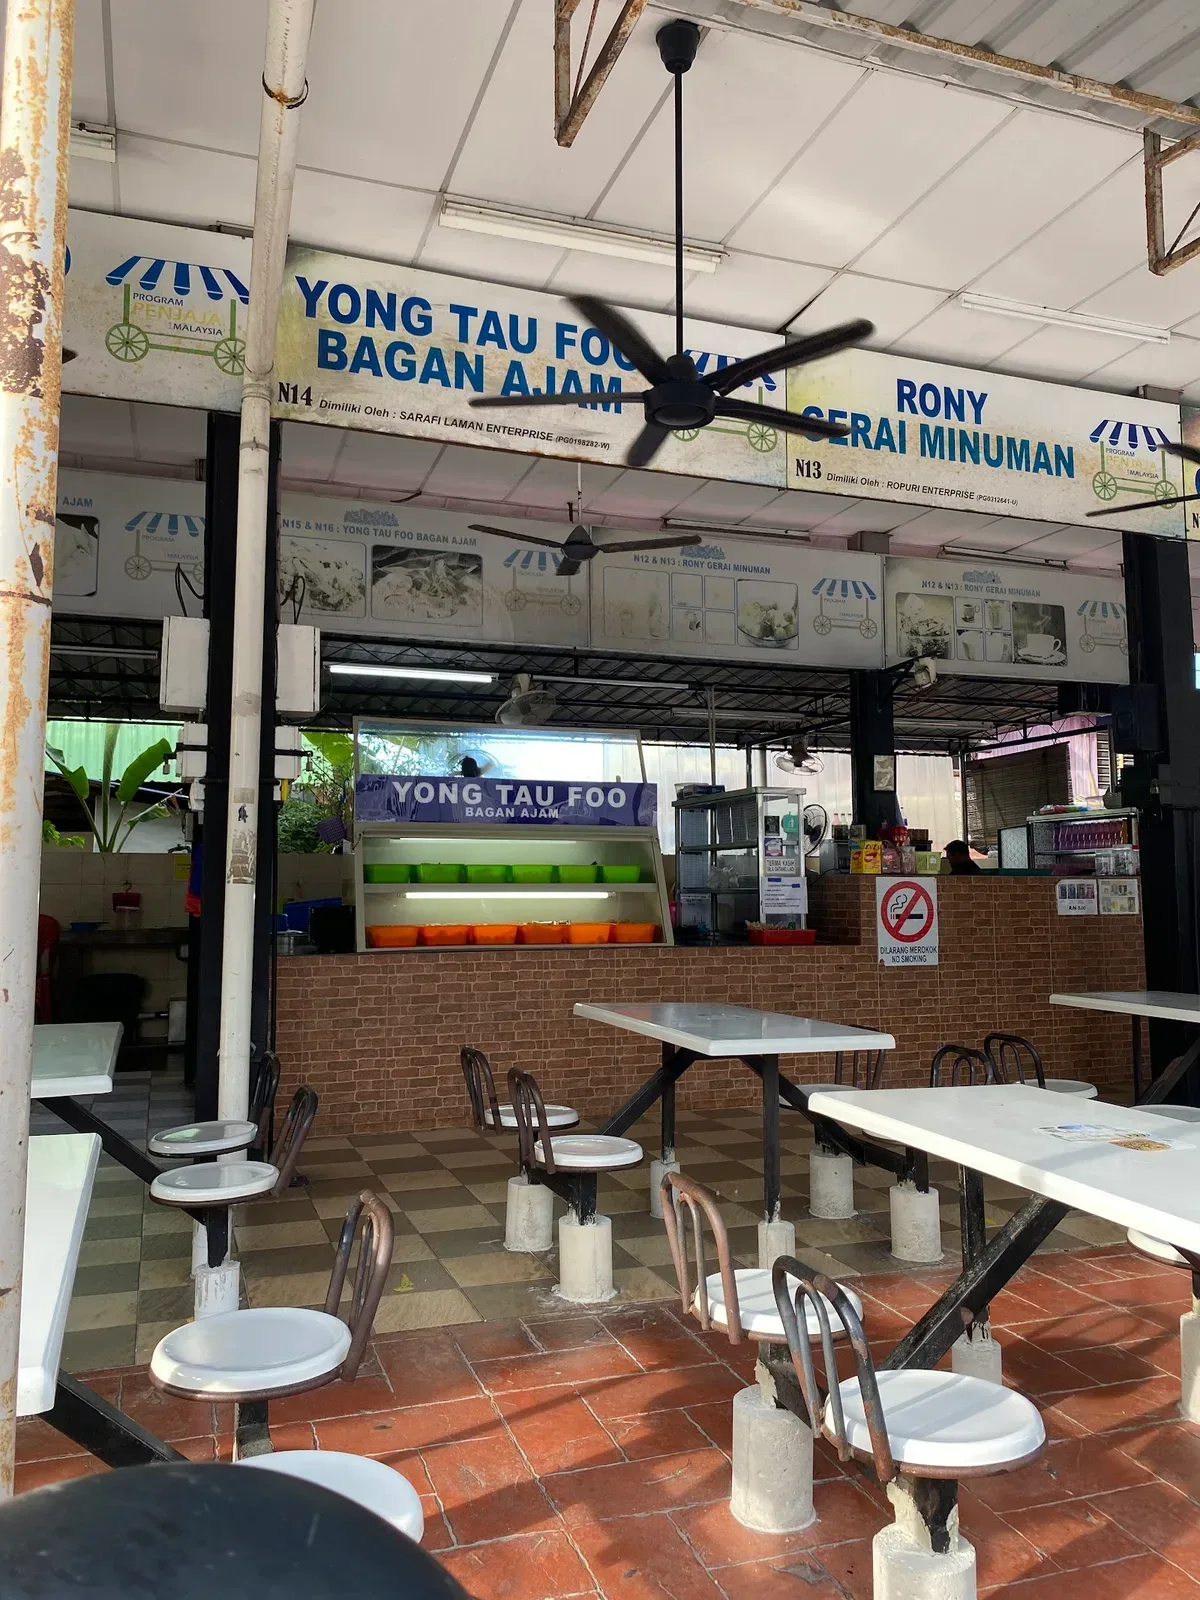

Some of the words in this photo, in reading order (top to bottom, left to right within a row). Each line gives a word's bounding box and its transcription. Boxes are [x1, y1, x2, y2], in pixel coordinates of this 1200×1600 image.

[133, 292, 184, 307] PROGRAM
[131, 302, 221, 325] PENJAJA
[295, 275, 433, 337] YONG
[449, 303, 538, 354] TAU
[317, 328, 484, 393] BAGAN
[500, 359, 622, 414] AJAM
[278, 382, 313, 407] N14
[896, 378, 989, 425] RONY
[319, 399, 361, 414] Dimiliki
[364, 405, 389, 418] Oleh
[399, 411, 441, 425] SARAFI
[444, 417, 484, 431] LAMAN
[486, 423, 554, 442] ENTERPRISE
[919, 422, 1075, 479] MINUMAN
[1105, 447, 1135, 457] PROGRAM
[795, 458, 822, 479] N13
[826, 472, 859, 485] Dimiliki
[860, 476, 880, 488] Oleh
[887, 481, 920, 493] ROPURI
[922, 485, 975, 500] ENTERPRISE
[62, 496, 93, 508] AJAM
[281, 518, 302, 529] N15
[304, 520, 312, 530] &
[314, 522, 334, 533] N16
[342, 524, 370, 537] YONG
[372, 528, 392, 538] TAU
[394, 530, 414, 540] FOO
[416, 532, 449, 544] BAGAN
[451, 536, 477, 547] AJAM
[633, 554, 650, 564] N12
[651, 555, 658, 564] &
[660, 556, 676, 566] N13
[682, 559, 705, 569] RONY
[707, 562, 731, 571] GERAI
[732, 564, 771, 575] MINUMAN
[937, 581, 943, 589] &
[964, 584, 984, 593] RONY
[985, 586, 1007, 594] GERAI
[1008, 587, 1041, 597] MINUMAN
[392, 781, 482, 805] YONG
[495, 784, 554, 806] TAU
[568, 786, 627, 808] FOO
[465, 806, 515, 818] BAGAN
[520, 807, 559, 819] AJAM
[880, 946, 909, 954] DILARANG
[909, 945, 938, 954] MEROKOK
[891, 955, 900, 963] NO
[901, 954, 927, 963] SMOKING
